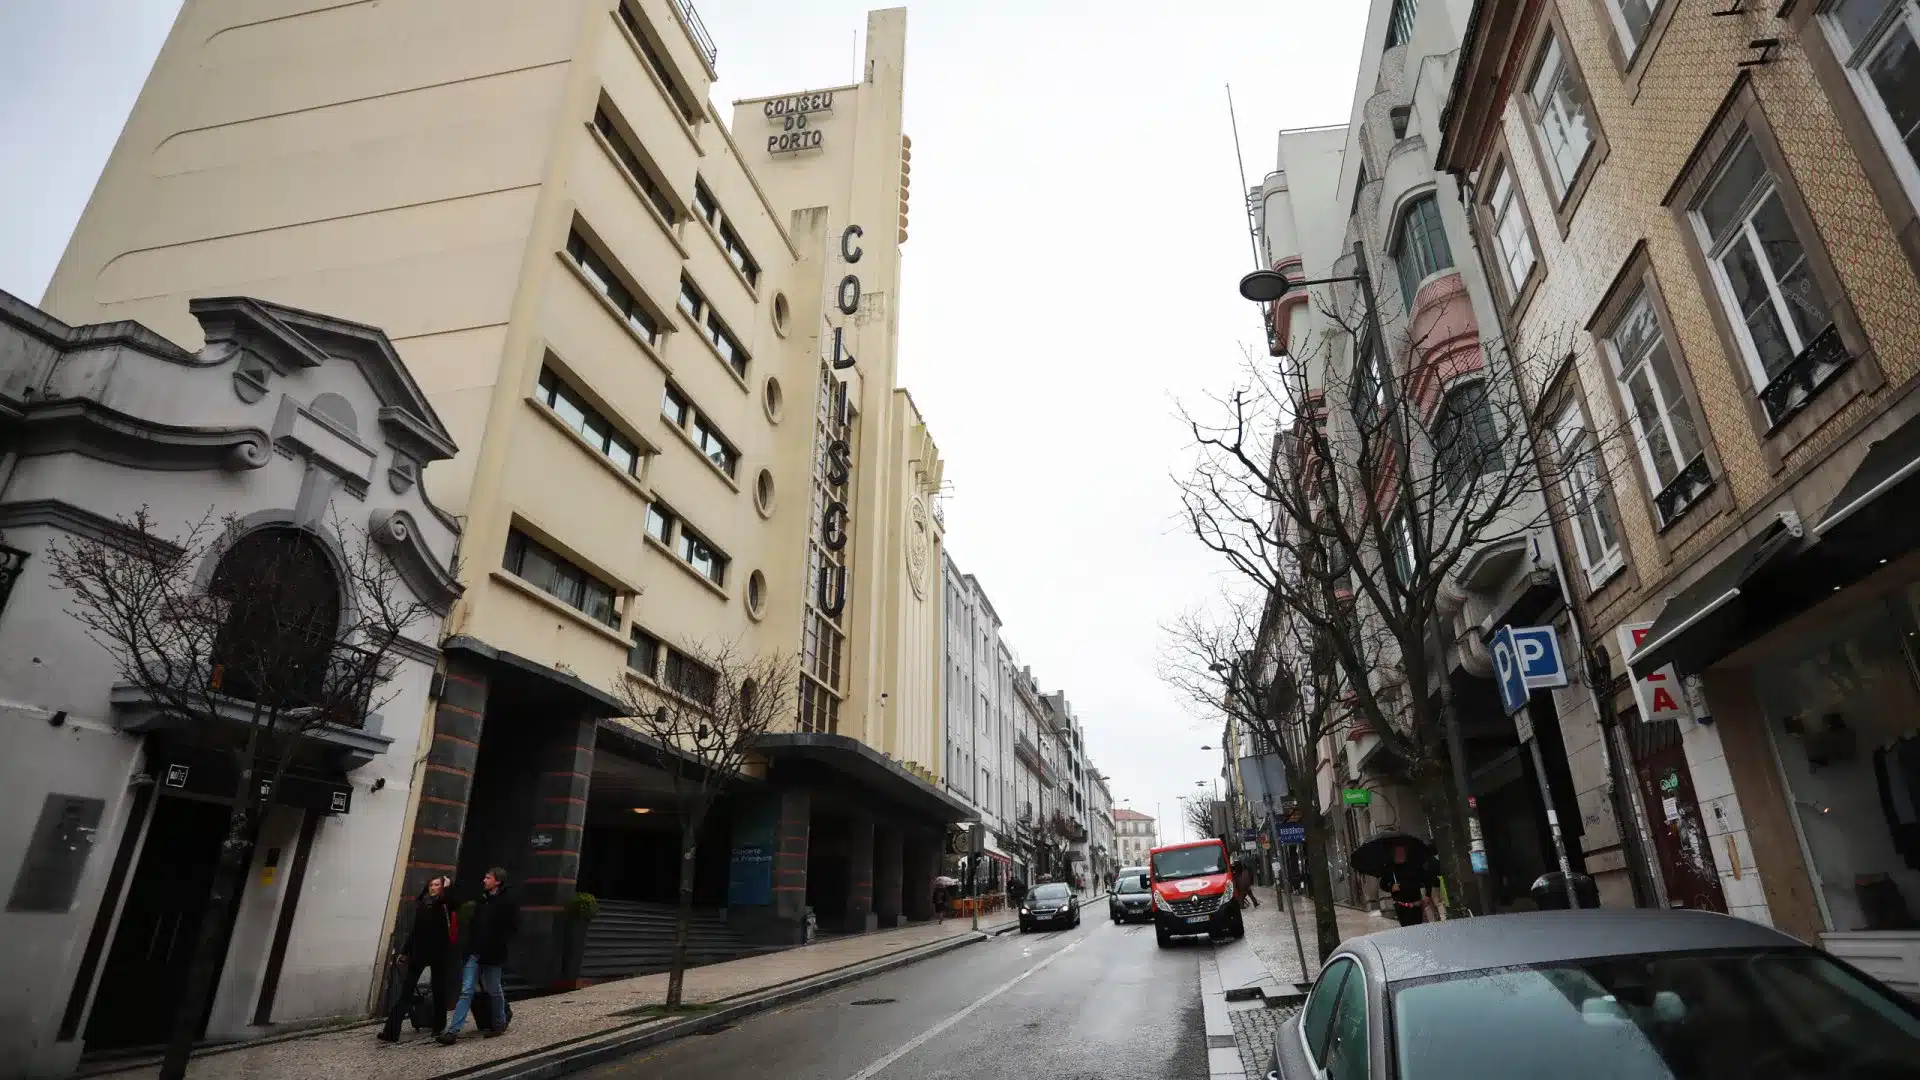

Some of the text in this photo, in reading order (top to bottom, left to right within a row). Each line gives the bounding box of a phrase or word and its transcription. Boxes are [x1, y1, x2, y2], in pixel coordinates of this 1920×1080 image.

[764, 92, 832, 116] COLISEU
[784, 113, 807, 131] DO
[767, 130, 822, 152] PORTO
[819, 224, 863, 618] COLISEU
[1516, 638, 1544, 671] P
[1494, 641, 1512, 706] P
